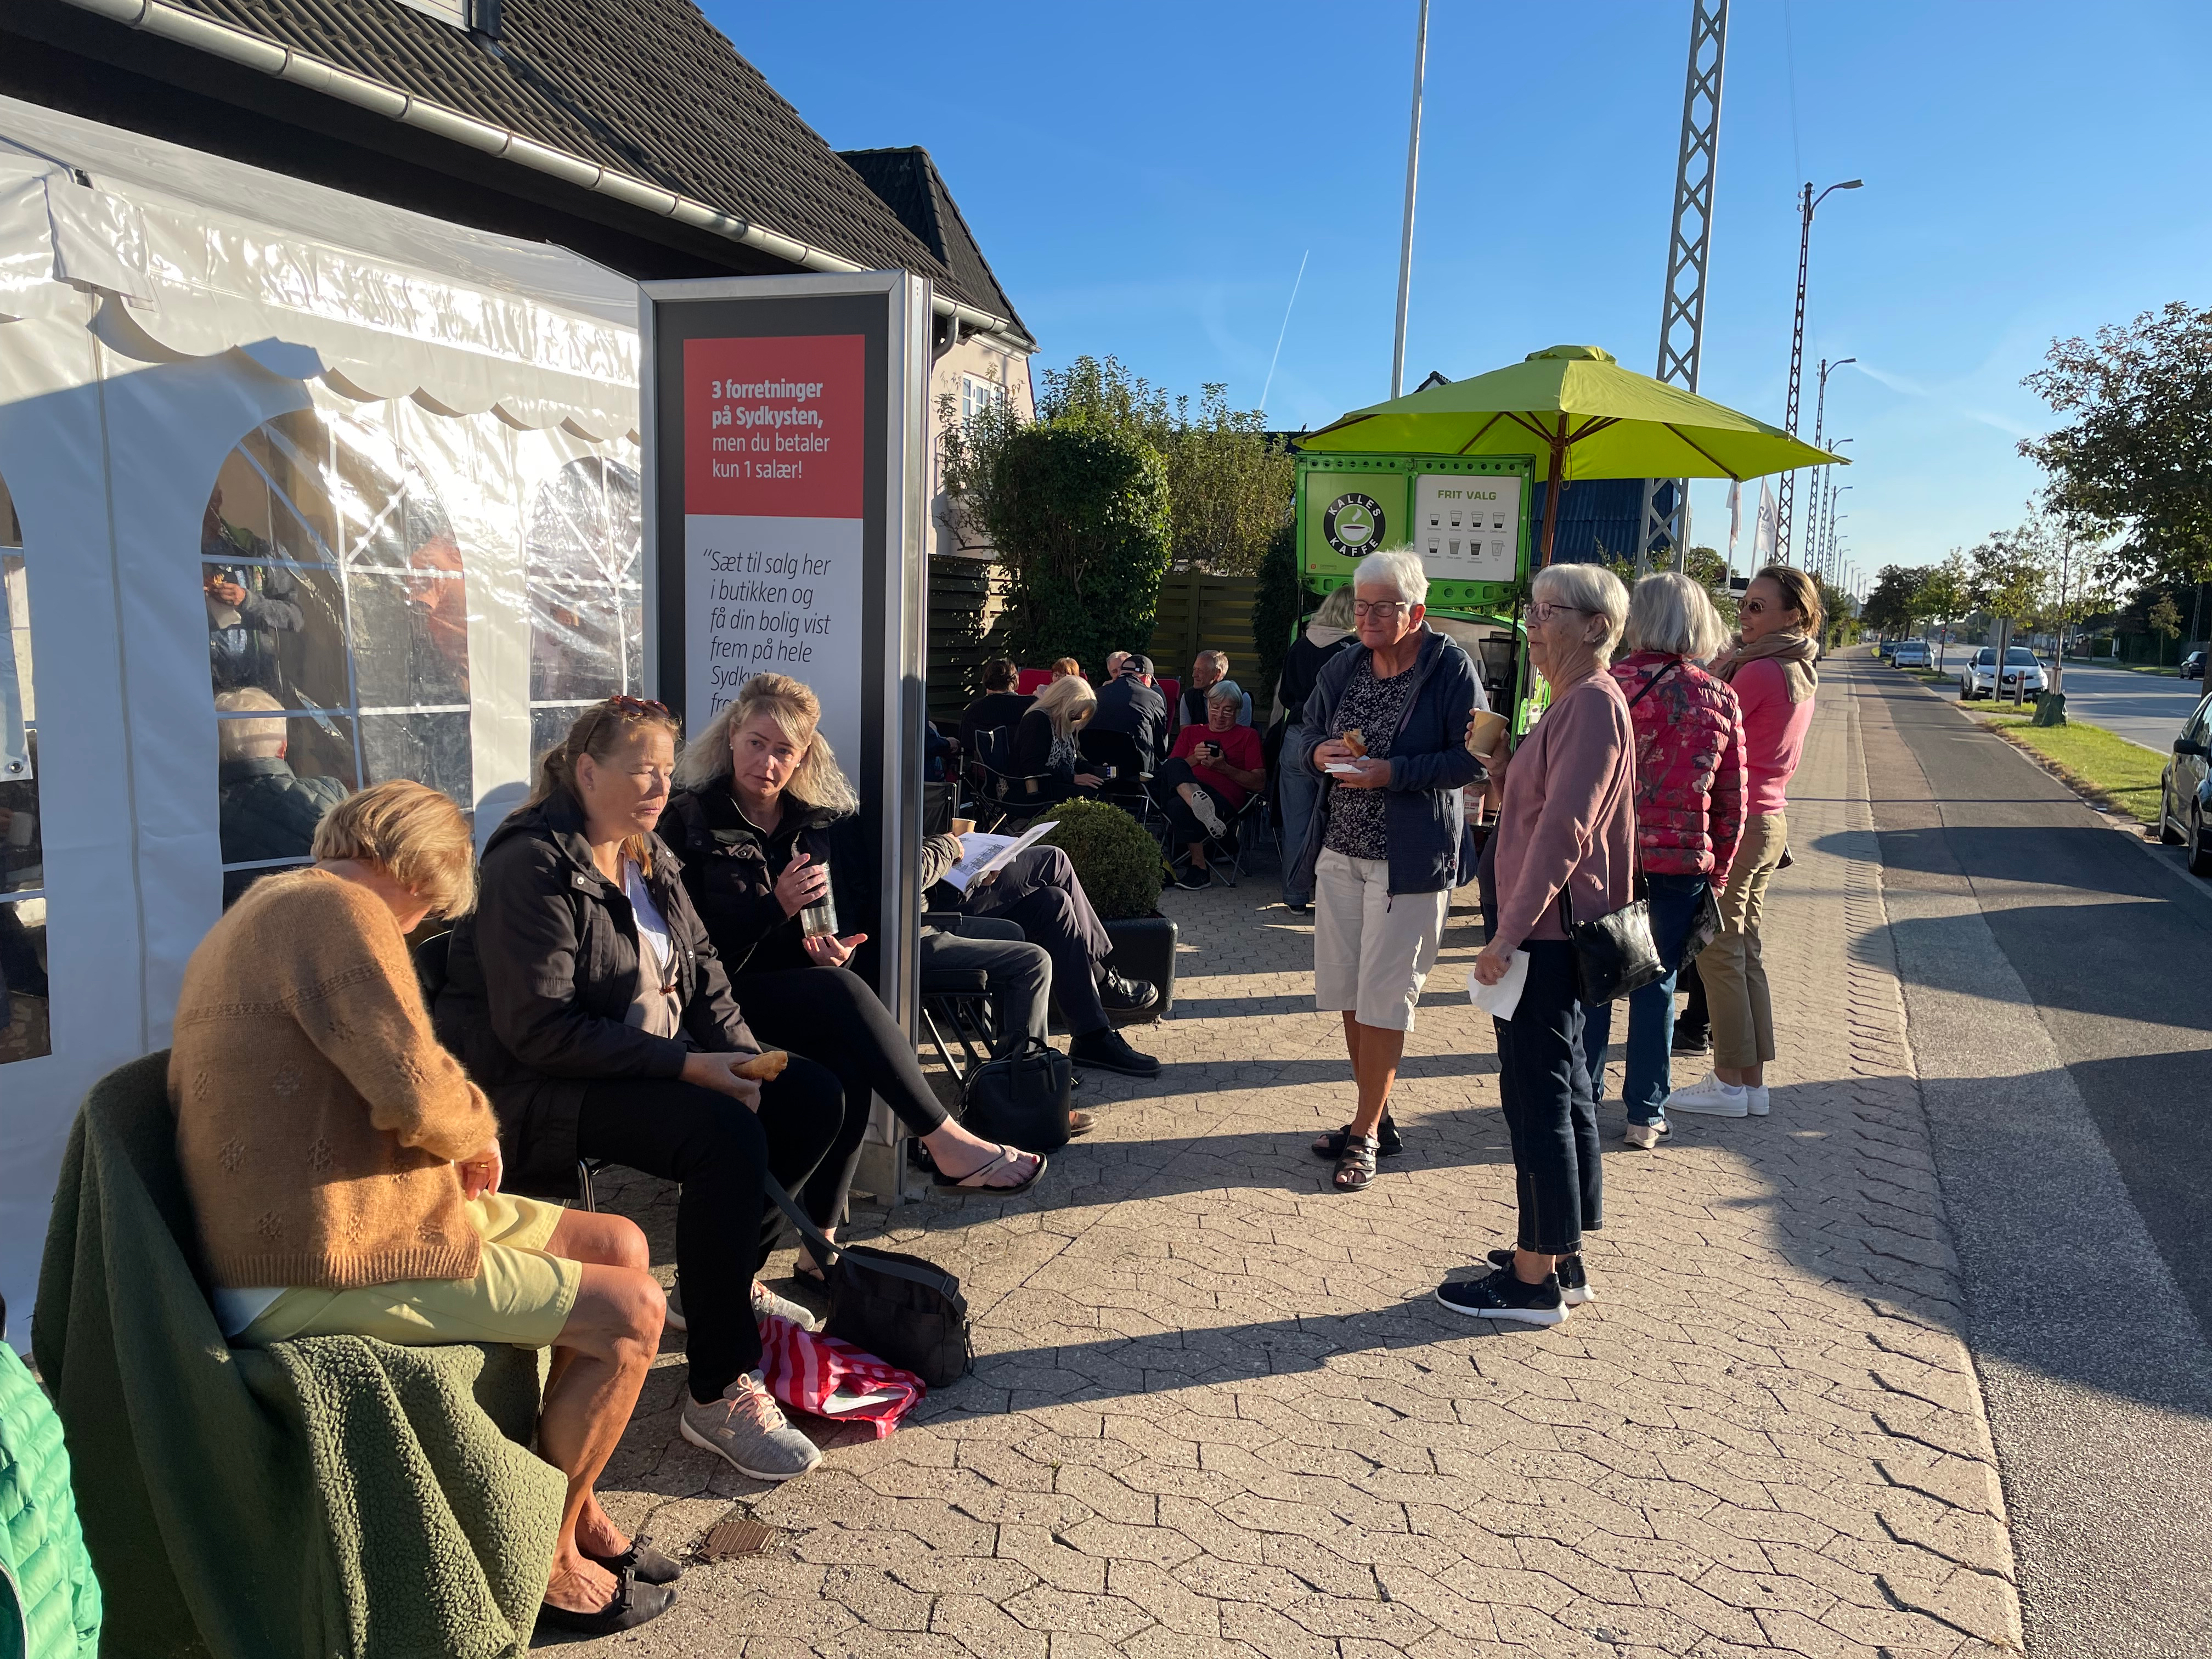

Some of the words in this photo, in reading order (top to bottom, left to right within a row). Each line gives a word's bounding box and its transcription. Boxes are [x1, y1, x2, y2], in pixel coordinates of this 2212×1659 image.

[712, 380, 722, 399] 3
[725, 378, 823, 402] forretninger
[712, 405, 732, 429] på
[736, 405, 823, 429] Sydkysten,
[712, 437, 747, 453] men
[751, 432, 771, 452] du
[775, 431, 831, 453] betaler
[712, 458, 740, 478] kun
[743, 460, 751, 478] 1
[755, 459, 803, 479] salær!
[1328, 495, 1381, 517] KALLES
[1438, 490, 1462, 499] FRIT
[1466, 491, 1497, 500] VALG
[1330, 537, 1378, 556] KAFFE
[747, 551, 762, 573] til
[764, 552, 798, 580] salg
[802, 552, 832, 575] her
[710, 578, 716, 600] i
[718, 579, 787, 603] butikken
[792, 588, 814, 610] og
[710, 606, 726, 634] få
[730, 608, 754, 630] din
[759, 610, 799, 638] bolig
[804, 613, 832, 635] vist
[710, 635, 748, 662] frem
[751, 637, 774, 664] på
[777, 639, 812, 663] hele
